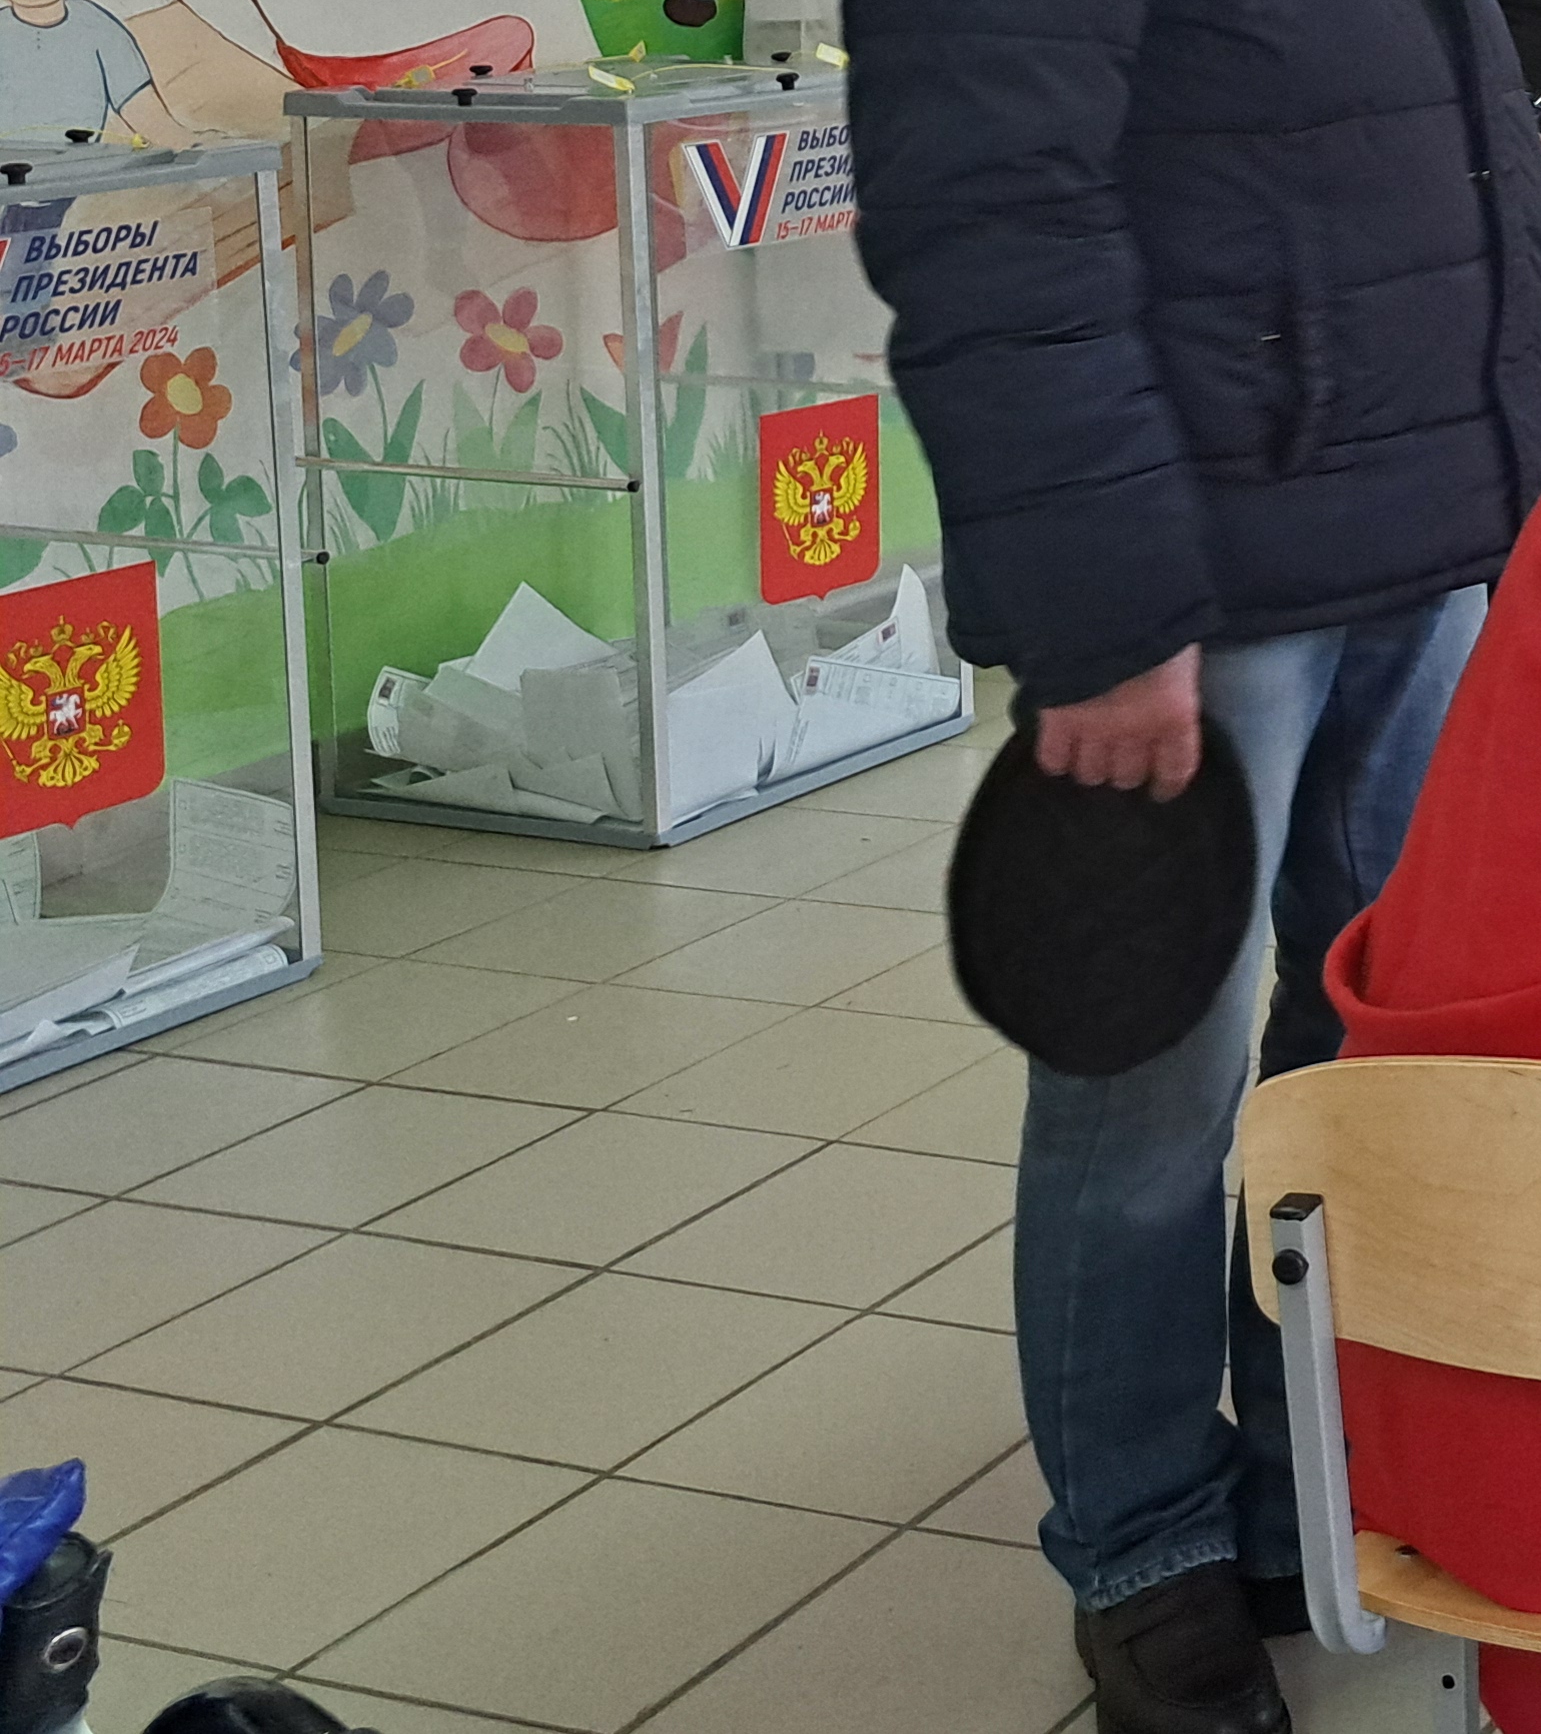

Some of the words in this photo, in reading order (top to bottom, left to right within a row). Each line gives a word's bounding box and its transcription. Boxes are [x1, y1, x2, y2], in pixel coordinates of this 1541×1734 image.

[797, 124, 849, 151] ВЫБО
[790, 152, 853, 182] ПРЕЗИ
[24, 220, 159, 264] ВЫБОРЫ
[10, 251, 199, 304] ПРЕЗИДЕНТА
[0, 299, 122, 343] РОССИИ
[52, 333, 126, 369] МАРТА
[128, 325, 180, 356] 2024
